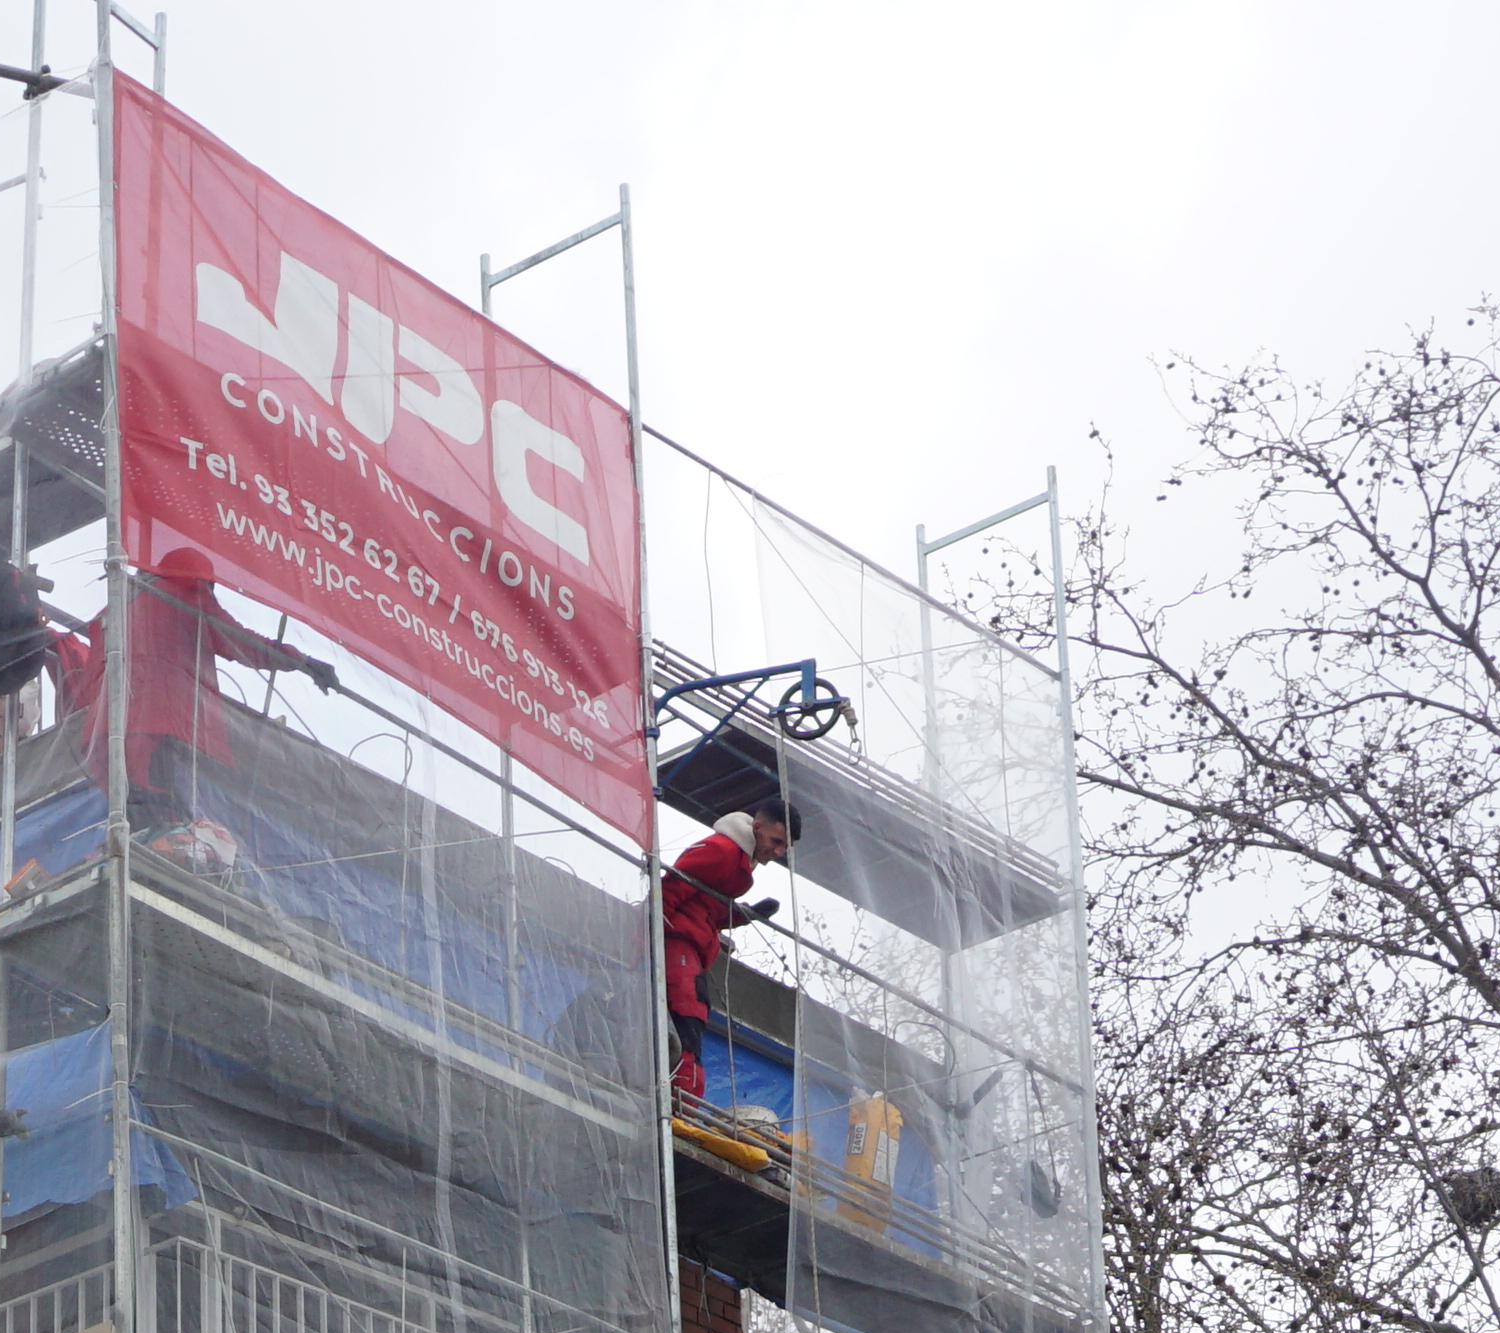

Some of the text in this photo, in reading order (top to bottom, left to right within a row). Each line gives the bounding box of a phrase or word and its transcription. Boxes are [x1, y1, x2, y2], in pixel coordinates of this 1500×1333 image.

[196, 251, 589, 566] JPC
[221, 373, 574, 620] CONSTRUCCIONS
[180, 437, 610, 729] Tel. 93 352 62 67 / 676 913 126
[217, 502, 594, 762] www.jpc-construccions.es
